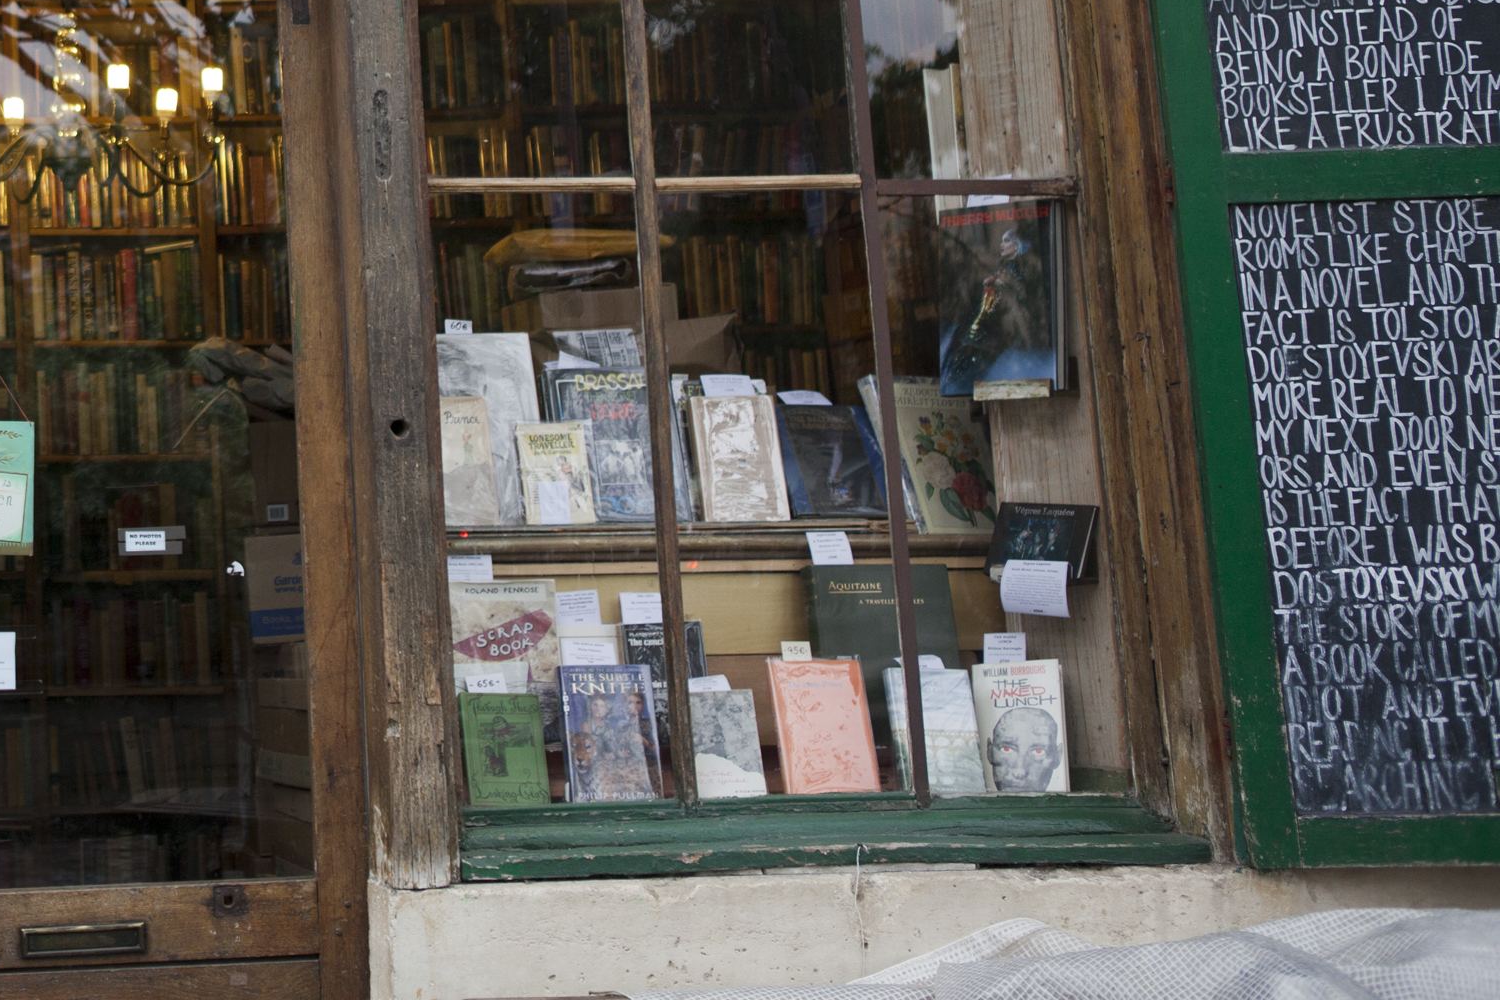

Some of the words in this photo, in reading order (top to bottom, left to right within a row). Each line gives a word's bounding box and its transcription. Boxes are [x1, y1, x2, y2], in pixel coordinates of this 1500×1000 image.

[941, 211, 993, 228] THIERRY
[995, 205, 1049, 222] MUGLER
[1234, 201, 1377, 240] NOVELIST
[1392, 198, 1493, 235] STORE
[1240, 270, 1268, 311] IN
[1274, 271, 1295, 311] A
[1409, 262, 1465, 306] AND
[449, 321, 468, 331] 60€
[1242, 308, 1315, 347] FACT
[1328, 308, 1356, 344] IS
[1361, 304, 1483, 342] TOLSTOI
[1252, 380, 1329, 421] MORE
[1330, 377, 1415, 419] REAL
[1414, 375, 1457, 416] TO
[444, 410, 481, 425] Prince
[529, 432, 573, 443] LONESOME
[528, 441, 575, 451] TRAVELLER
[465, 586, 499, 594] ROLAND
[503, 586, 539, 594] PENROSE
[828, 581, 882, 591] AQUITAINE
[476, 622, 534, 648] SCRAP
[489, 637, 535, 657] BOOK
[569, 673, 595, 682] THE
[599, 672, 644, 682] SUBTLE
[983, 667, 1008, 678] WILLIAM
[1010, 665, 1046, 676] BURROUGHS
[572, 682, 647, 696] KNIFE
[993, 678, 1031, 689] THE
[990, 686, 1046, 700] NAKED
[994, 694, 1057, 709] LUNCH
[578, 791, 608, 800] PHILIP
[612, 791, 659, 800] PULLMAN
